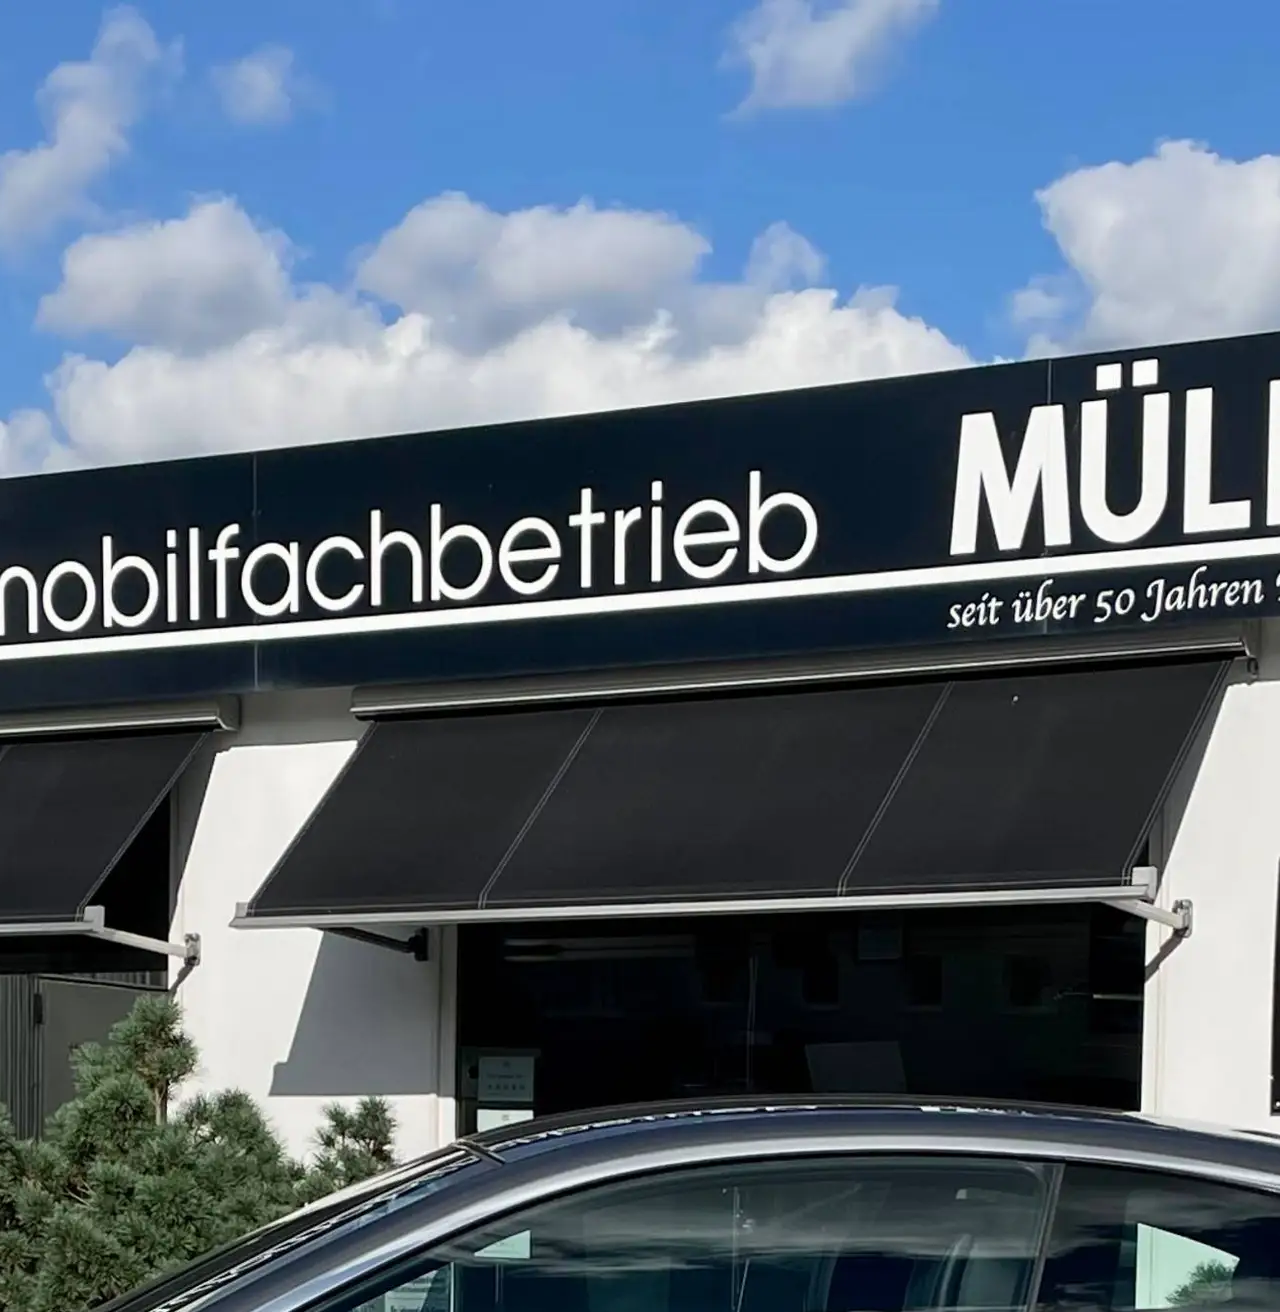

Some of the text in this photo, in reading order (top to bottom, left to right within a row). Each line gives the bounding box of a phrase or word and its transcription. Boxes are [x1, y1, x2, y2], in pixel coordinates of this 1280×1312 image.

[947, 592, 1003, 628] seit
[1012, 578, 1086, 623] über
[1093, 588, 1136, 623] 50
[1140, 565, 1264, 622] Jahren
